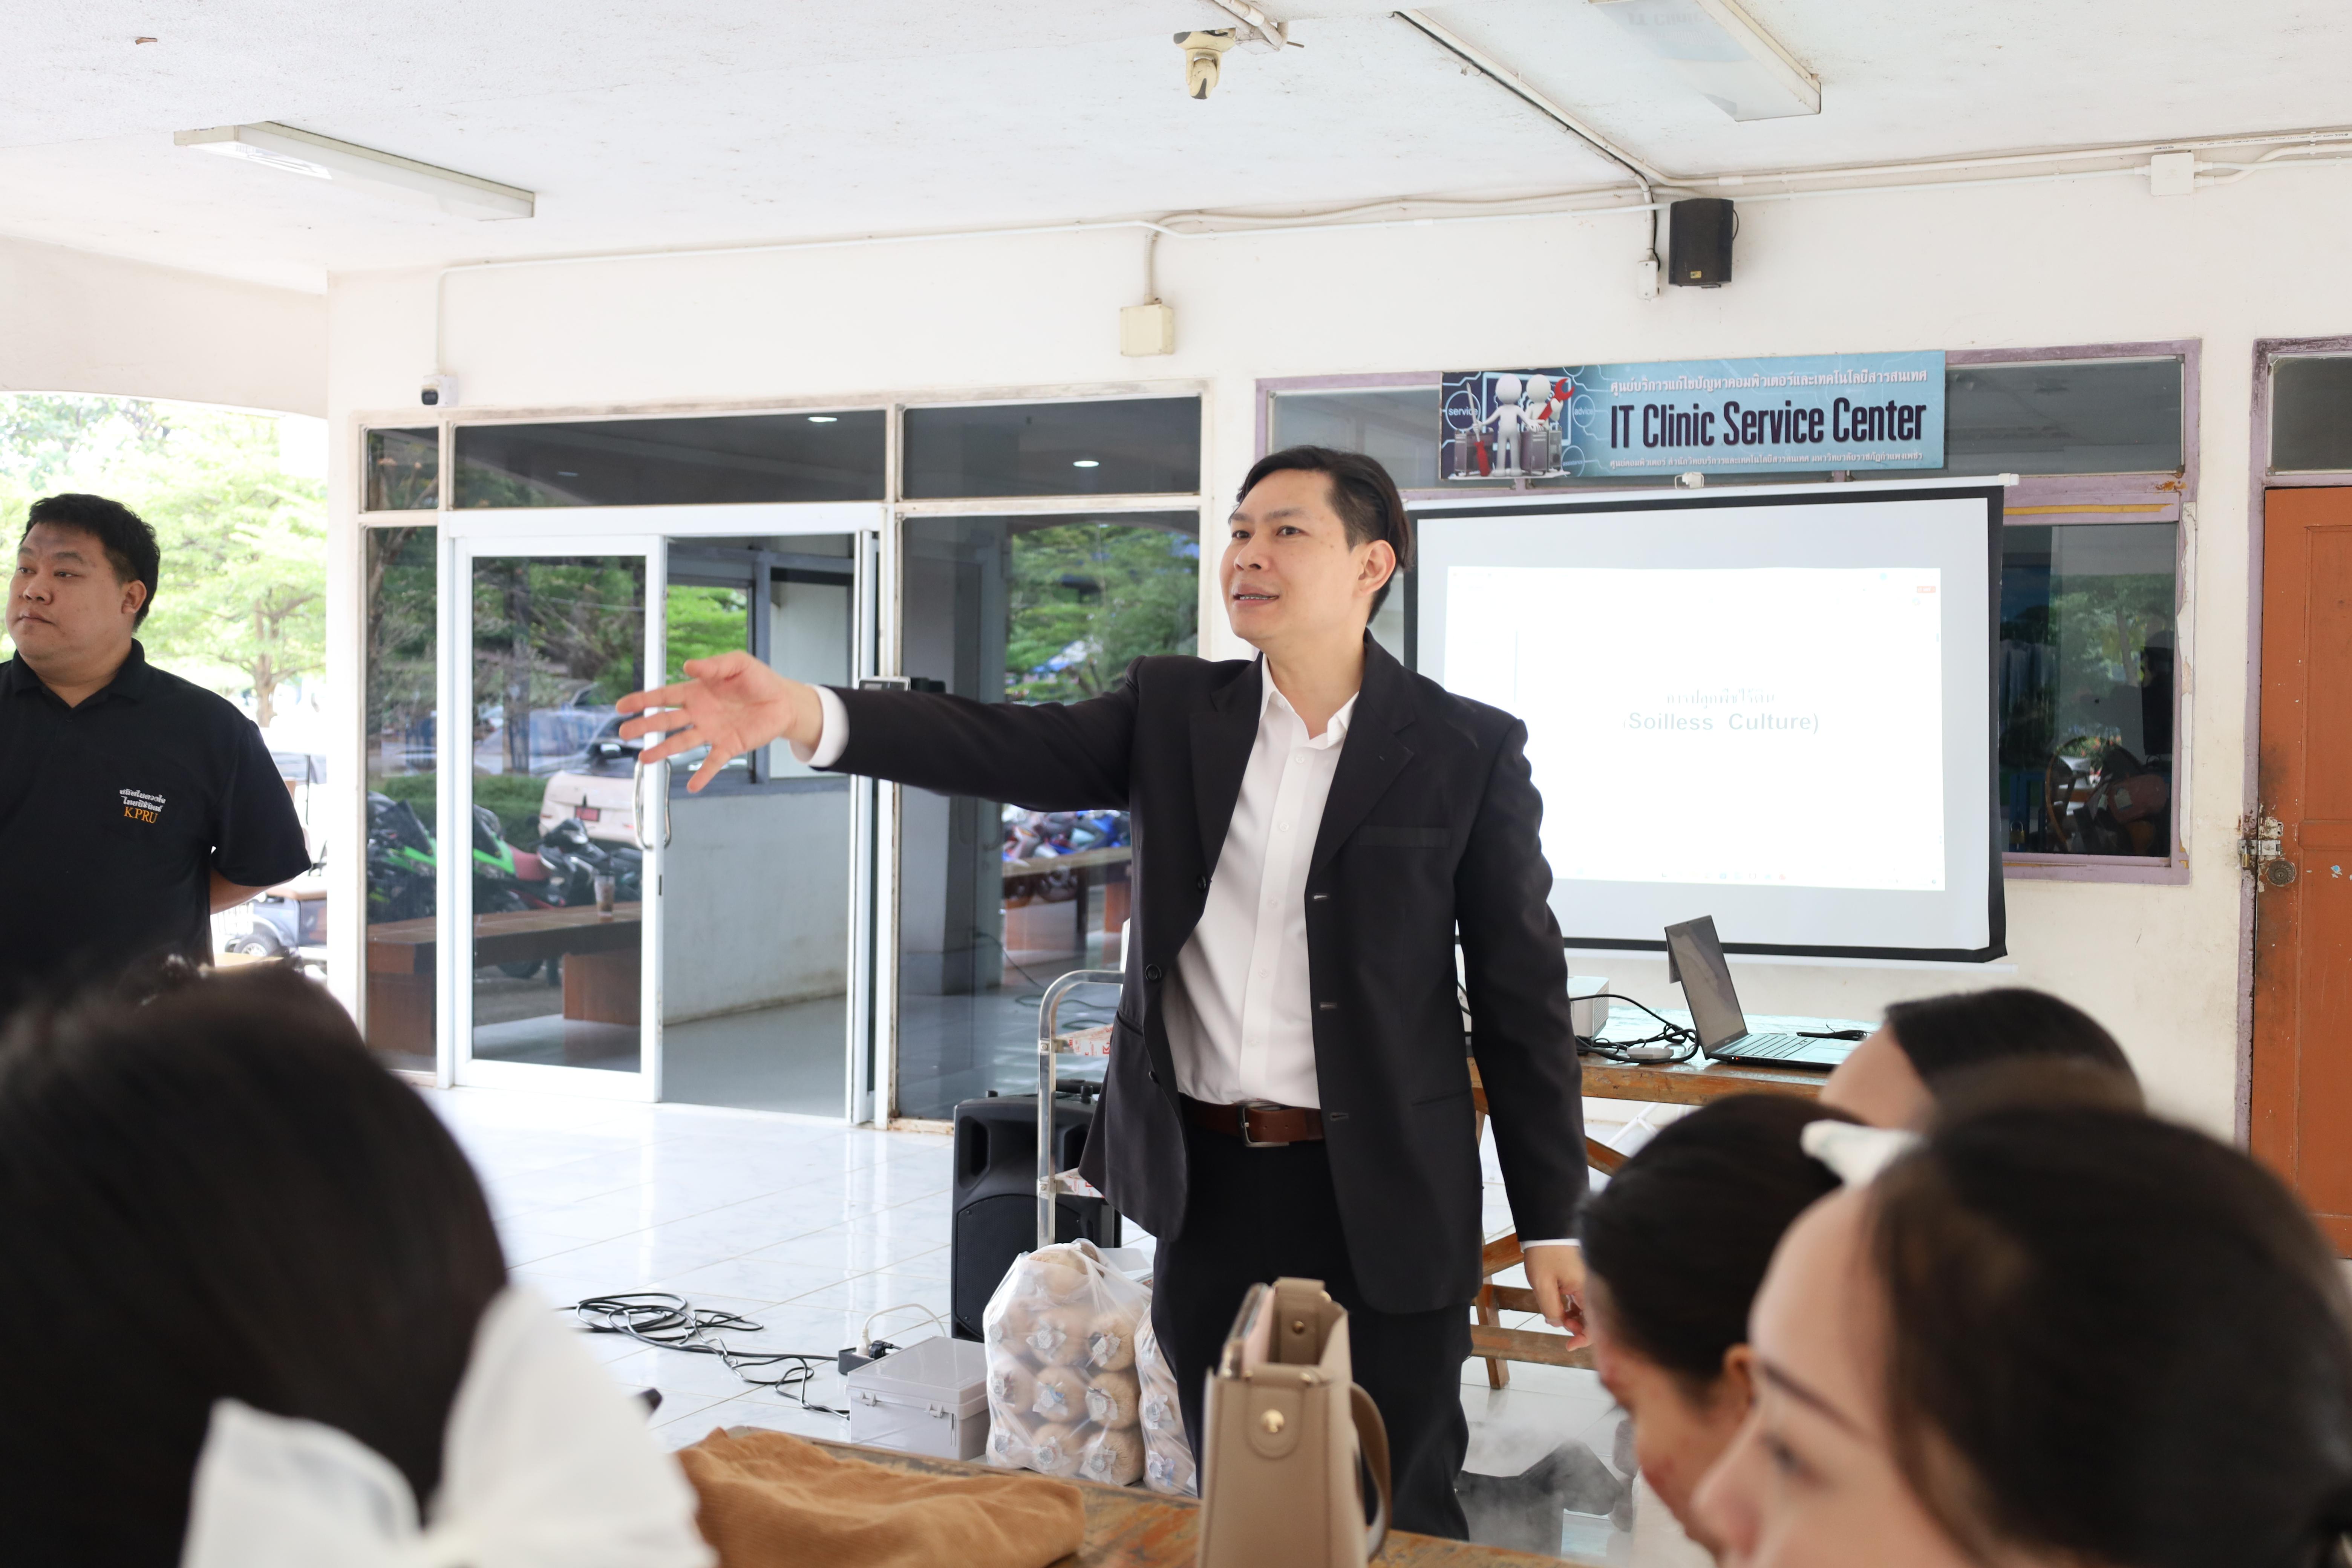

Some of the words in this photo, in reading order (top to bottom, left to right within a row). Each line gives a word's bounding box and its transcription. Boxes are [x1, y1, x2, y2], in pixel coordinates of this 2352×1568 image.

[1574, 407, 1593, 415] advice
[1611, 404, 1635, 448] IT
[1643, 403, 1715, 448] Clinic
[1723, 400, 1824, 446] Service
[1833, 397, 1926, 443] Center
[1729, 712, 1819, 735] Culture)
[124, 806, 158, 824] KPRU
